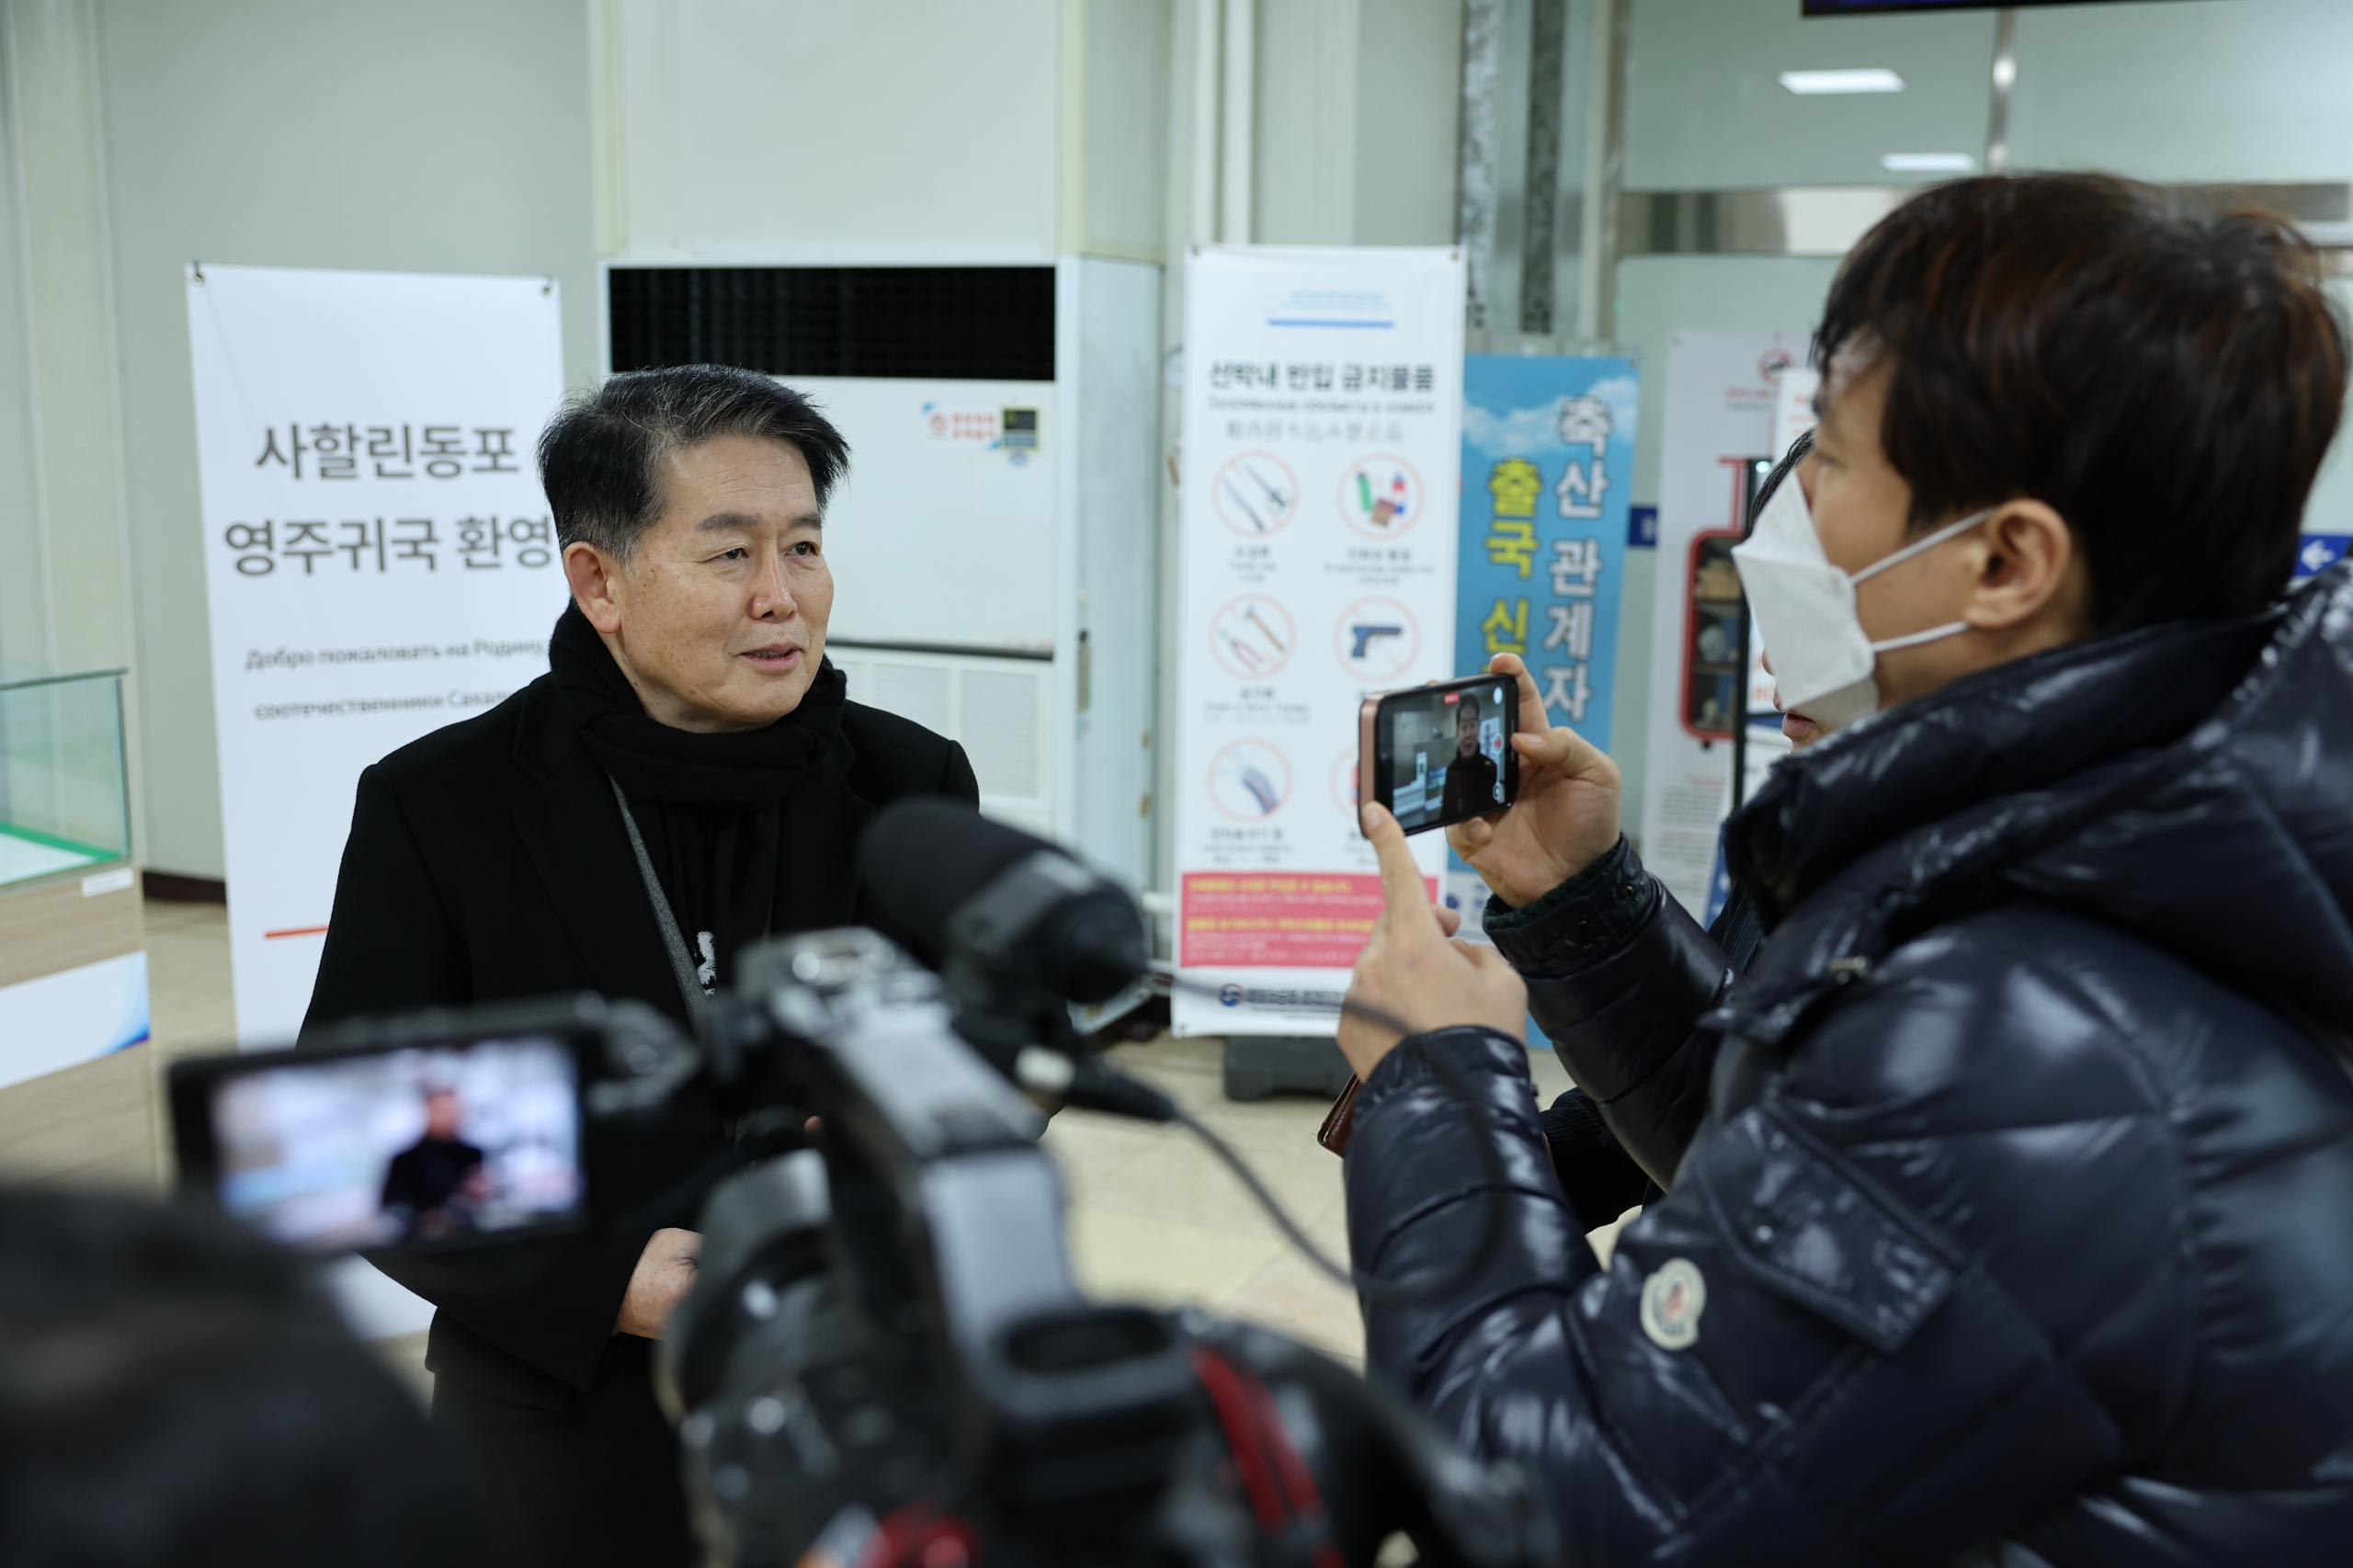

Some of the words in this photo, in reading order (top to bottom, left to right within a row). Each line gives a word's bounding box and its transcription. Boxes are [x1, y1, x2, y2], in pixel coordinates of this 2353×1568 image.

[255, 422, 519, 482] 사할린동포
[1557, 395, 1613, 517] 축산
[224, 517, 439, 577] 영주귀국
[457, 514, 552, 571] 환영
[1486, 458, 1541, 580] 출국
[245, 646, 316, 672] Добро
[318, 643, 442, 664] пожаловать
[445, 642, 470, 658] на
[1482, 597, 1529, 672] 신
[1543, 537, 1602, 722] 관계자
[254, 696, 444, 721] соотечественники
